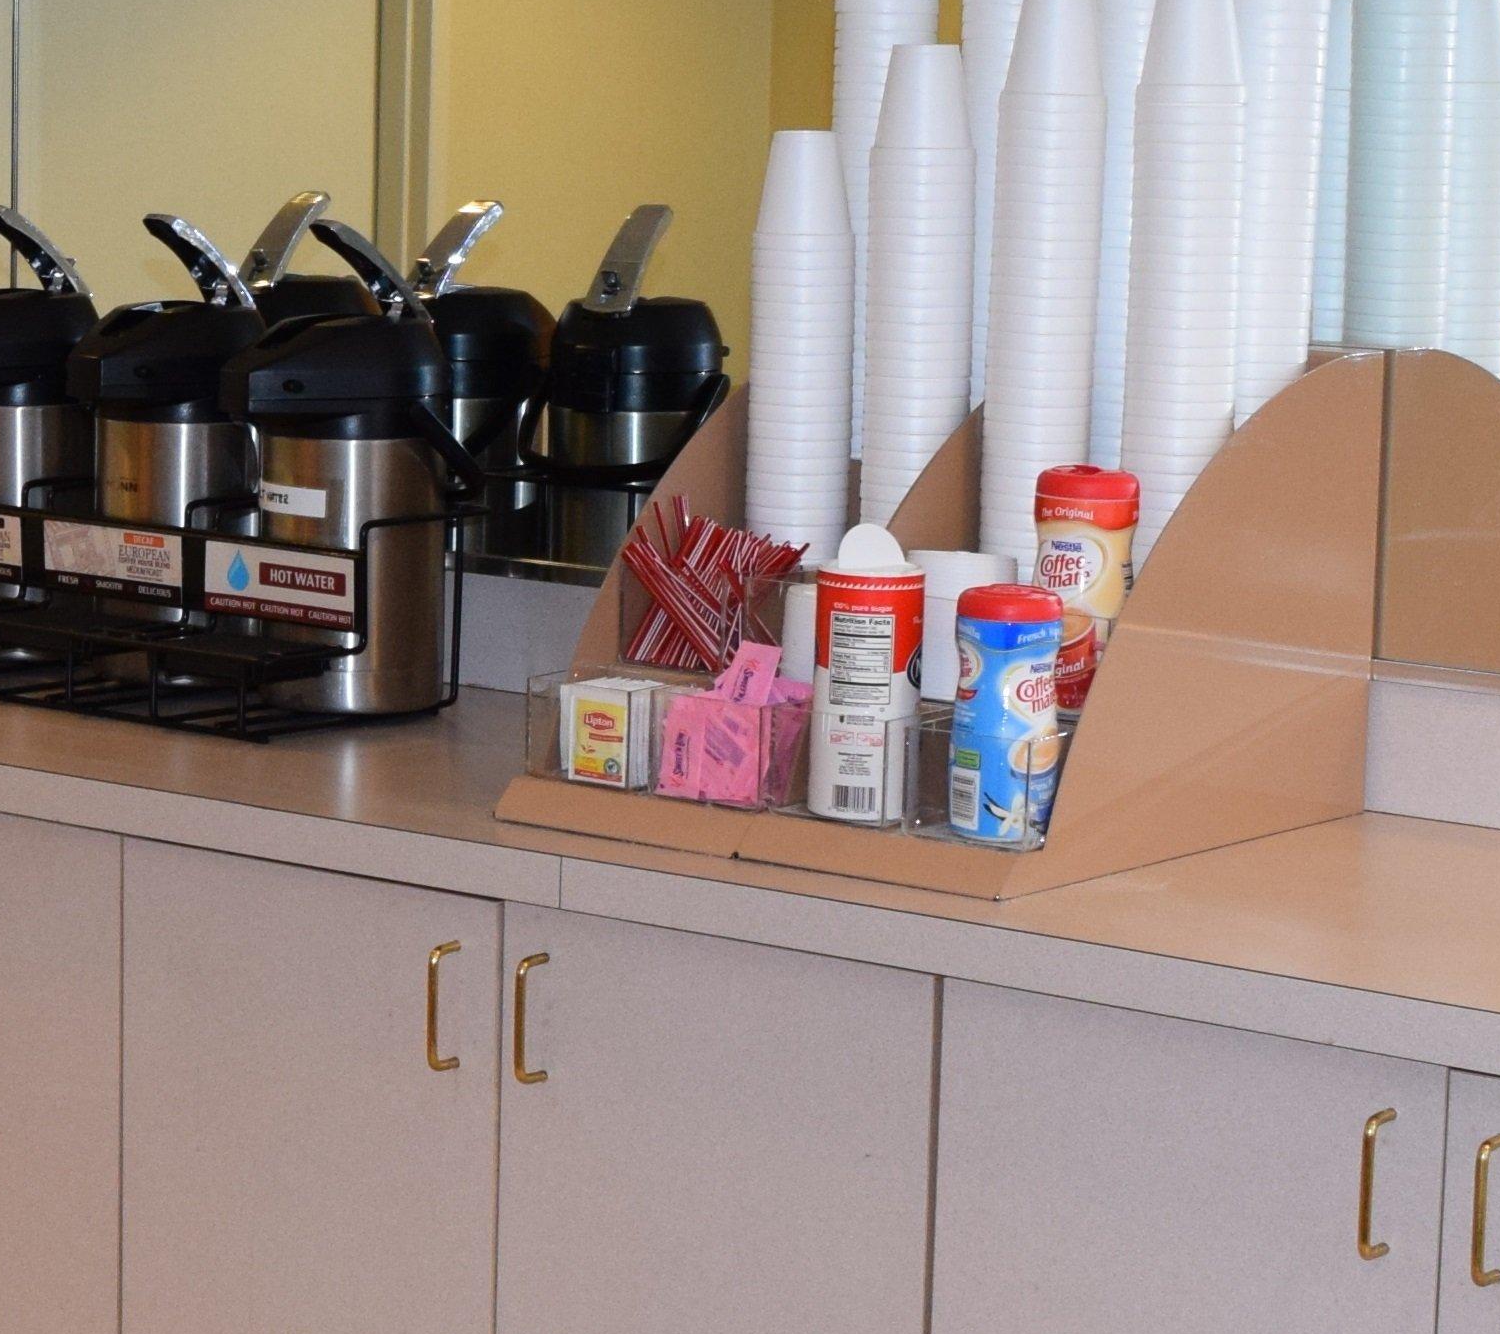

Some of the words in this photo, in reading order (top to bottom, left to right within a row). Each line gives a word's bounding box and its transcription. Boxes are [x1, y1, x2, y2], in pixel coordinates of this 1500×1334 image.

[1055, 507, 1094, 521] Original
[118, 545, 171, 562] EUROPEAN
[270, 568, 292, 585] HOT
[294, 572, 335, 591] WATER
[210, 597, 241, 609] CAUTION
[260, 603, 289, 616] CAUTION
[308, 610, 338, 623] CAUTION
[585, 714, 613, 728] Lipton
